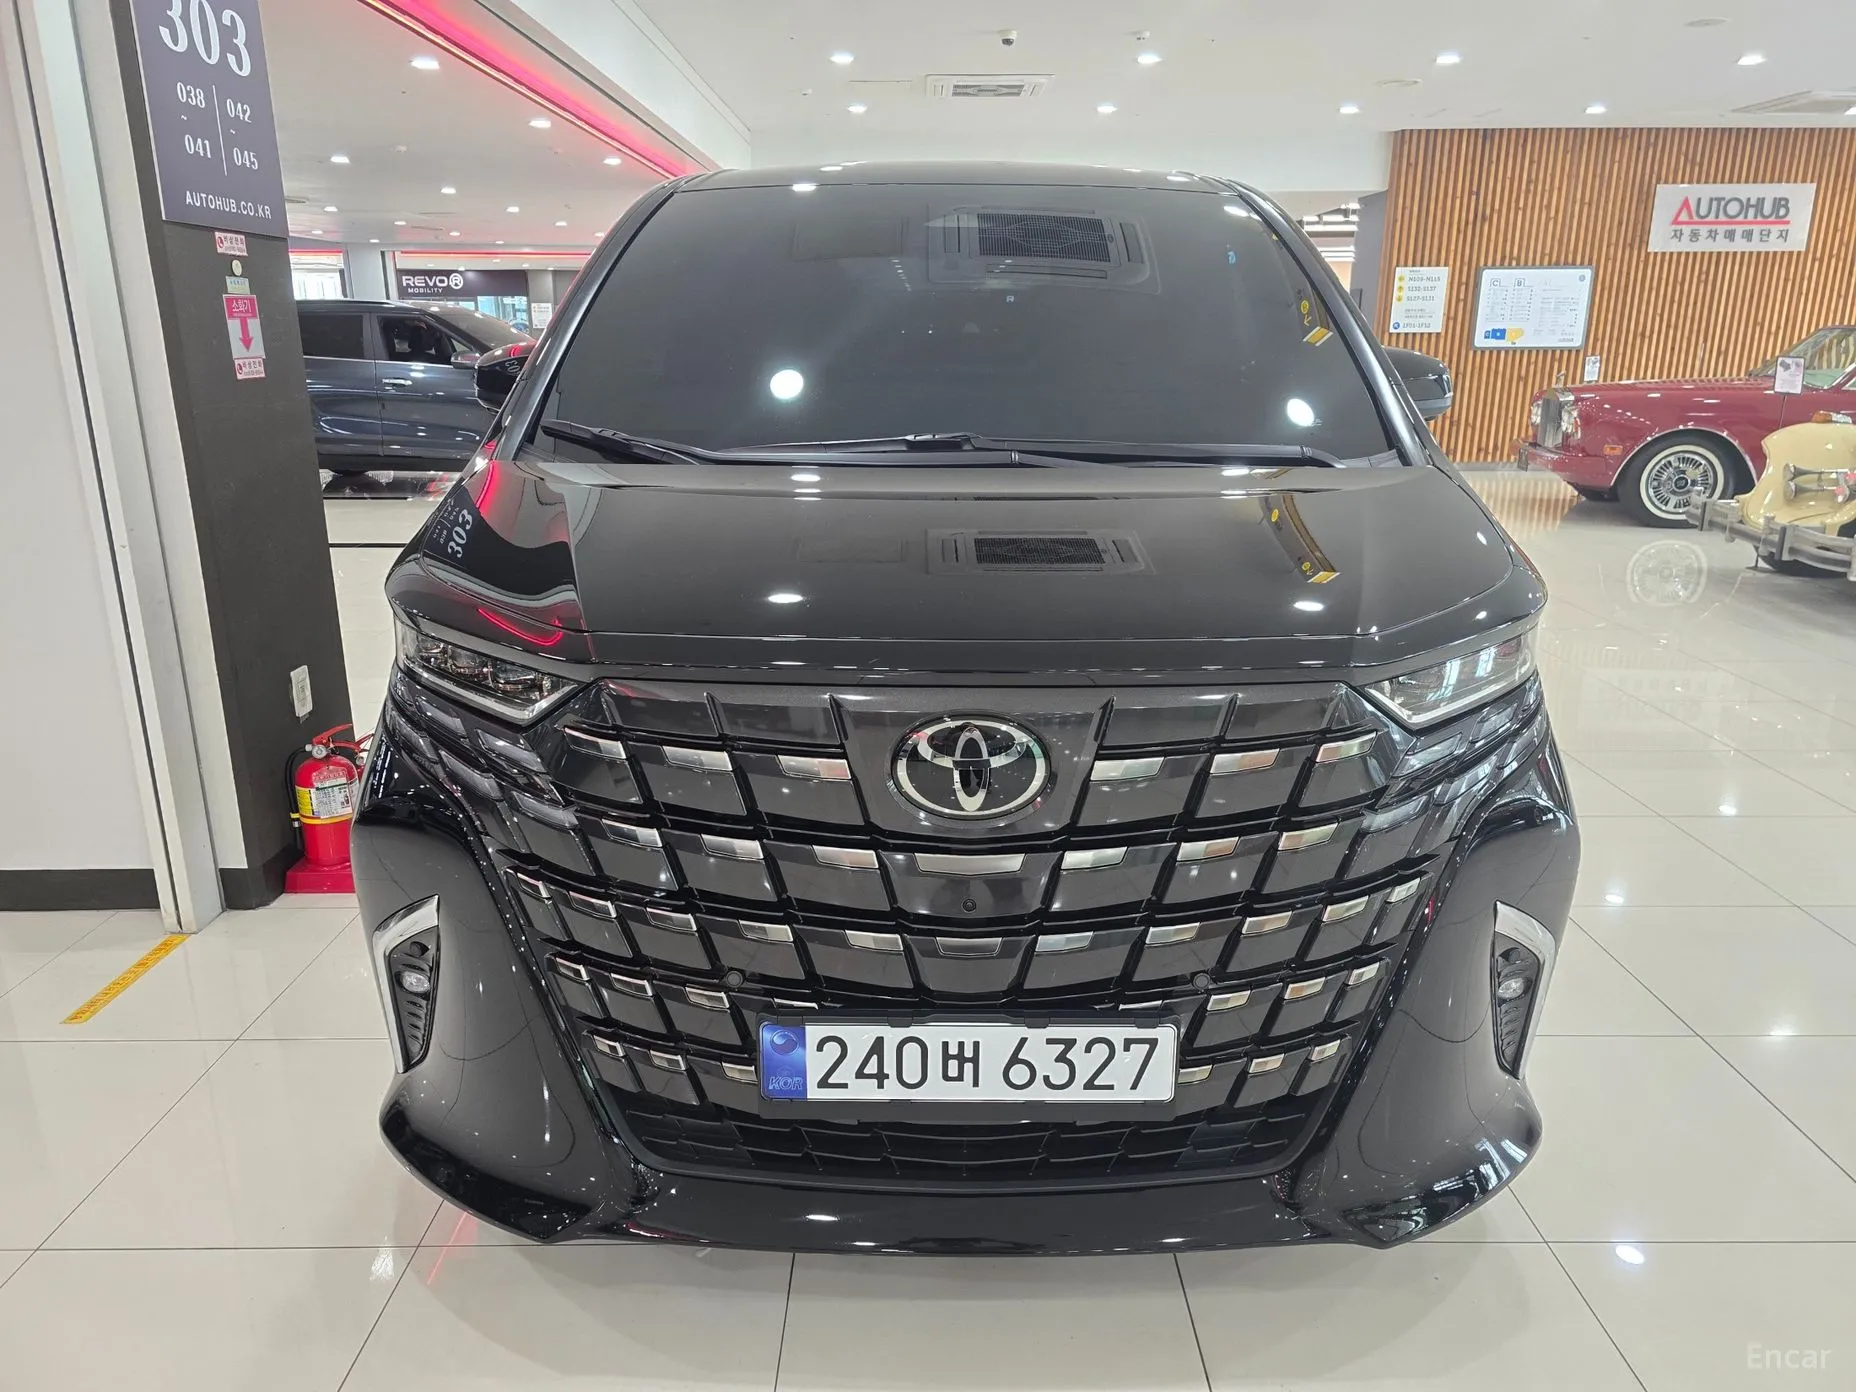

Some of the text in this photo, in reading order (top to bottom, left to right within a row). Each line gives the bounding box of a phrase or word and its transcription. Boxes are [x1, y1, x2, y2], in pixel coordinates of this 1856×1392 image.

[158, 0, 251, 77] 303
[176, 81, 206, 109] 038
[226, 98, 252, 123] 042
[184, 133, 211, 159] 041
[232, 147, 259, 170] 045
[185, 190, 272, 220] AUTOHUB.CO.KR
[1671, 195, 1791, 226] AUTOHUB
[1669, 228, 1790, 243] 자동차매매단지
[402, 275, 448, 287] REVO
[232, 299, 252, 312] 소화기
[815, 1035, 1159, 1091] 240버 6327
[768, 1075, 803, 1090] KOR
